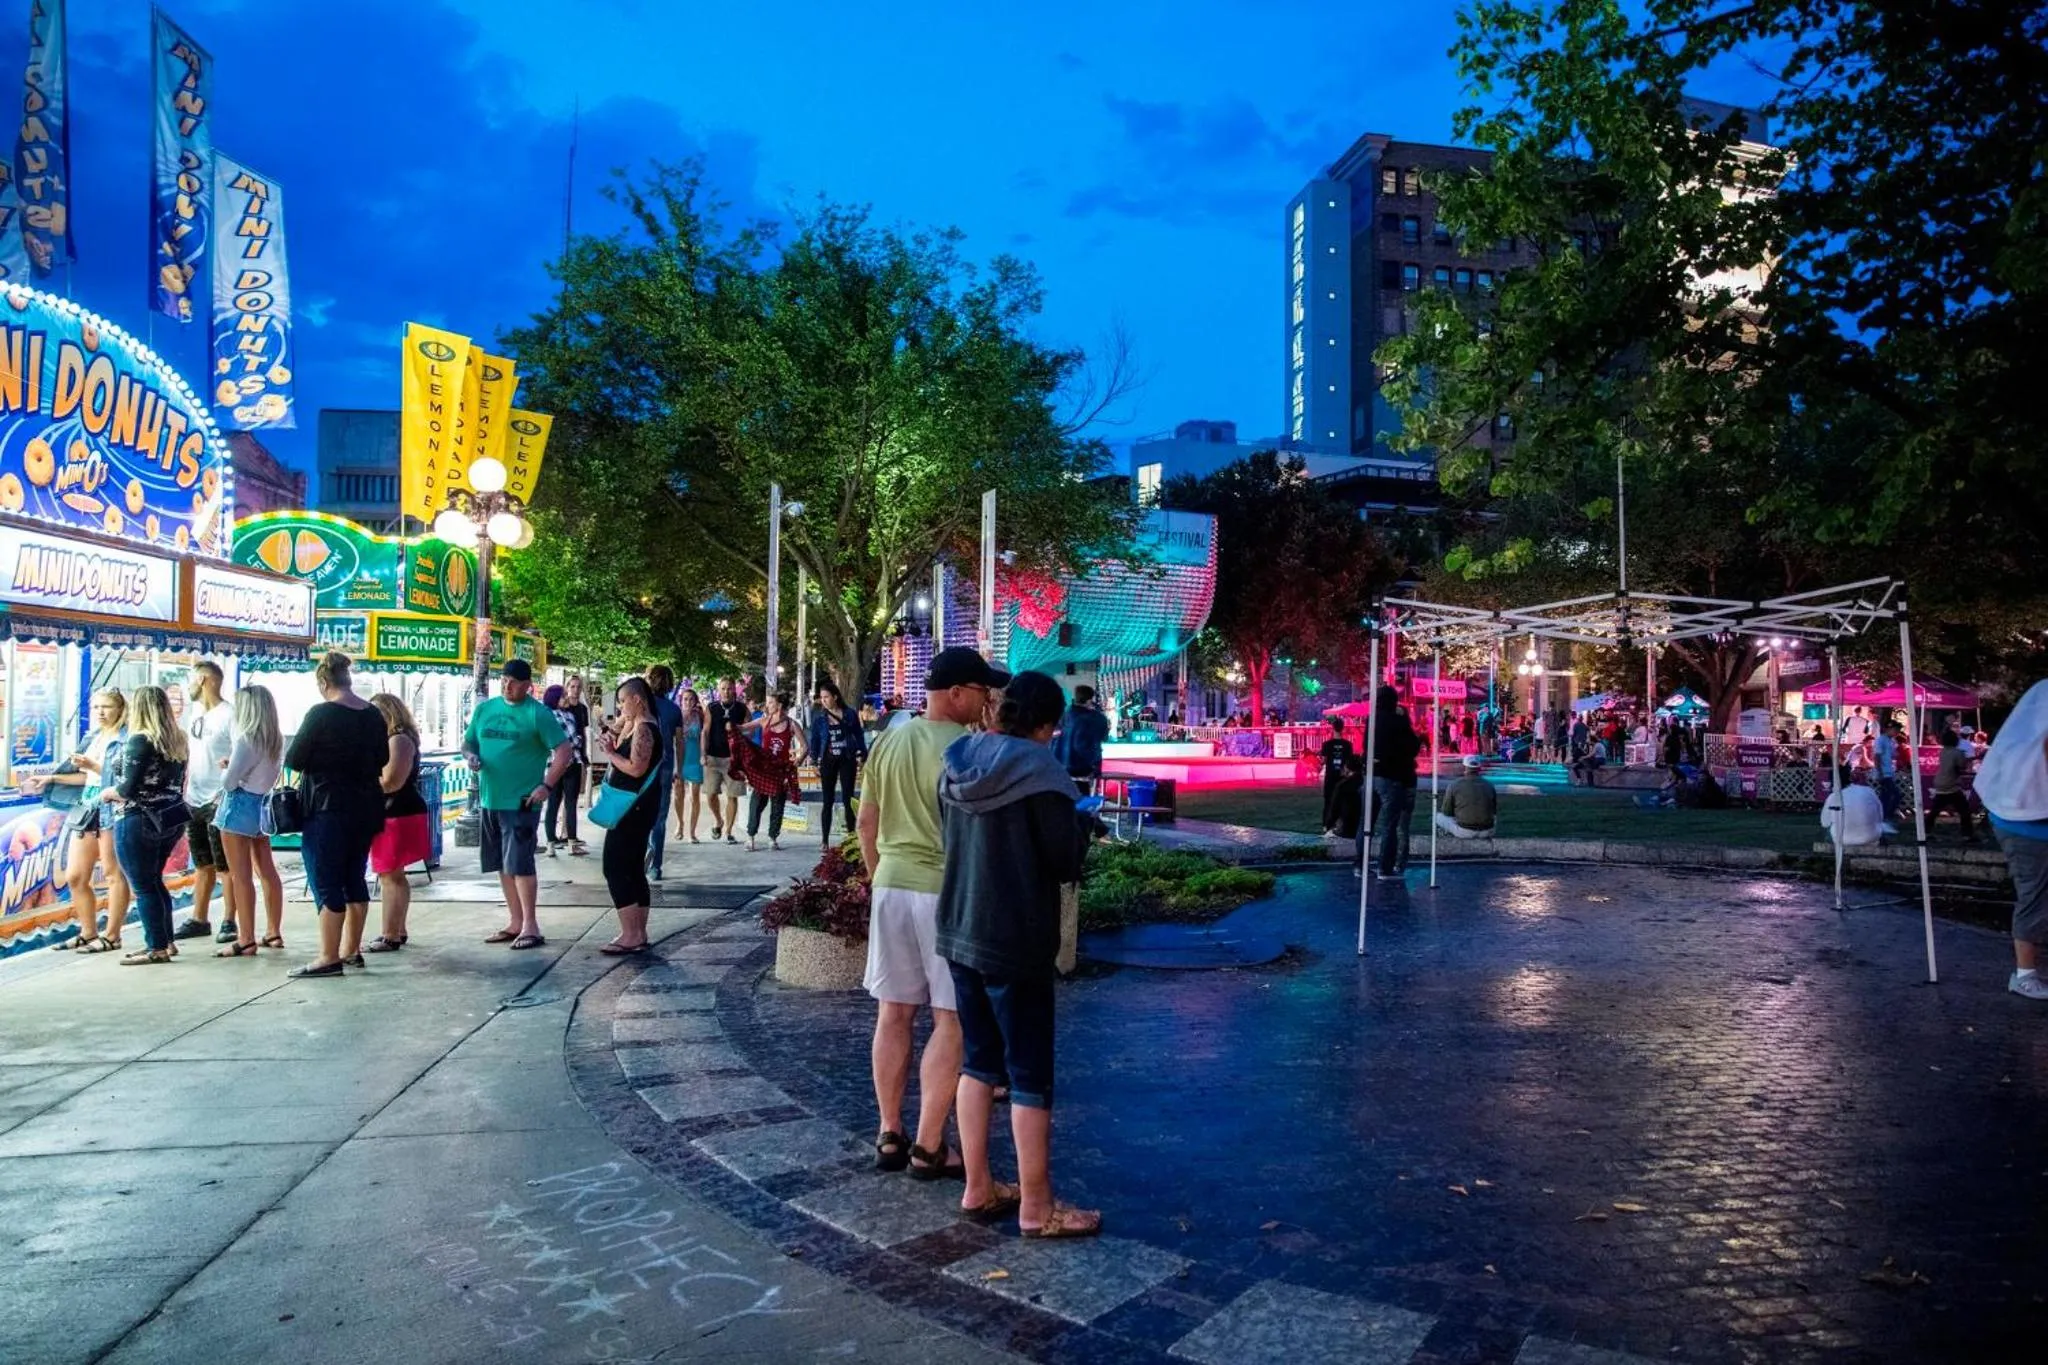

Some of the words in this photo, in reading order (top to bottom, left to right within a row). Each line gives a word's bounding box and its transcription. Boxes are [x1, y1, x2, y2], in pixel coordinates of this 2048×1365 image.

[228, 171, 270, 260] MINI
[232, 268, 273, 397] DONUTS
[52, 341, 206, 490] DONUTS
[423, 364, 443, 508] LEMONADE
[1157, 531, 1206, 549] FESTIVAL
[12, 543, 72, 596] MINI
[71, 553, 148, 607] DONUTS
[342, 591, 391, 601] LEMONADE
[380, 634, 457, 653] LEMONADE
[417, 664, 451, 673] LEMONADE
[1742, 756, 1769, 765] PATIO
[530, 1161, 815, 1330] PROPHECY
